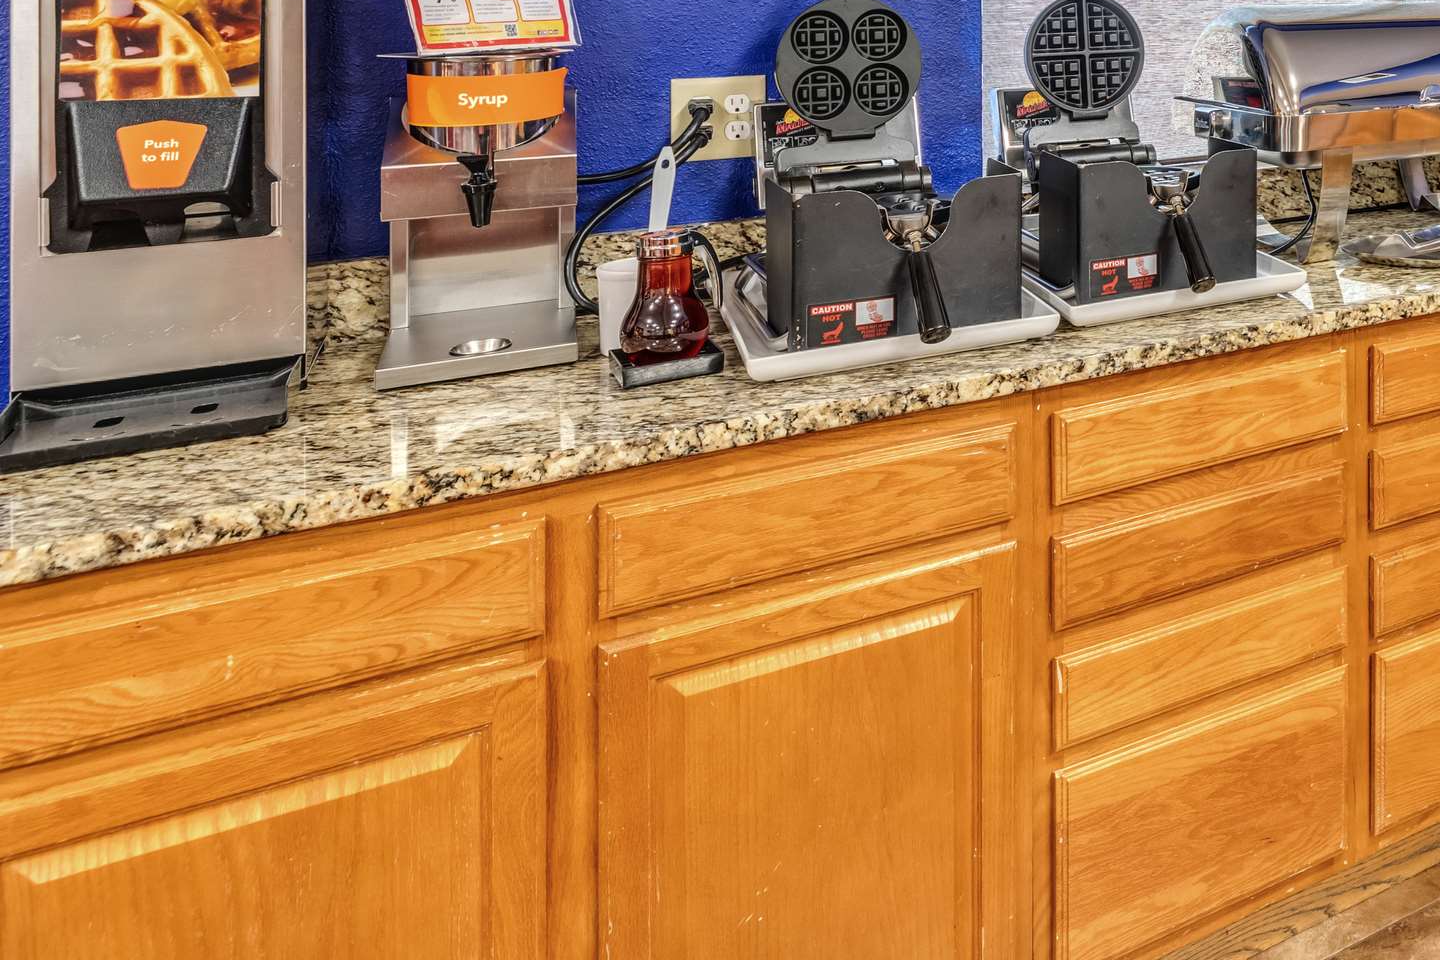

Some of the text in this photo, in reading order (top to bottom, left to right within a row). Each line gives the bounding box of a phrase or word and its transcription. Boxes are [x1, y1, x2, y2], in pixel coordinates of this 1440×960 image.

[458, 93, 508, 109] Syrup
[144, 139, 179, 149] Push
[141, 151, 179, 163] to fill
[1093, 259, 1125, 270] CAUTION
[811, 302, 854, 315] CAUTION
[822, 314, 841, 322] HOT
